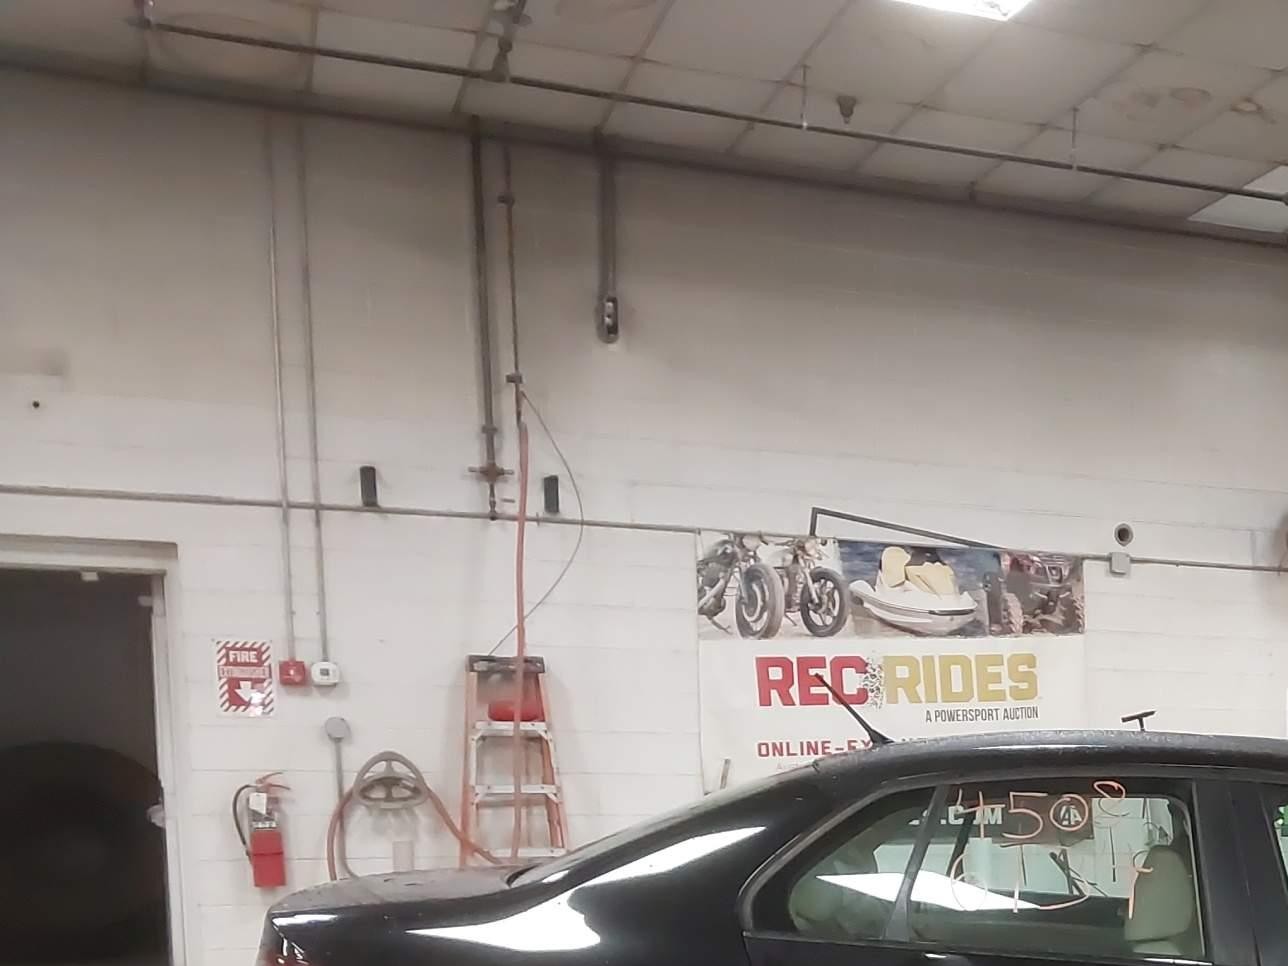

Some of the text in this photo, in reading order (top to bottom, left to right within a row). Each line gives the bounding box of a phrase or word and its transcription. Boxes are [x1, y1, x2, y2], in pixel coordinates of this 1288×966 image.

[229, 650, 258, 662] FIRE
[755, 653, 1039, 707] REC RIDES
[925, 706, 1039, 723] A POWERSPORT AUCTION
